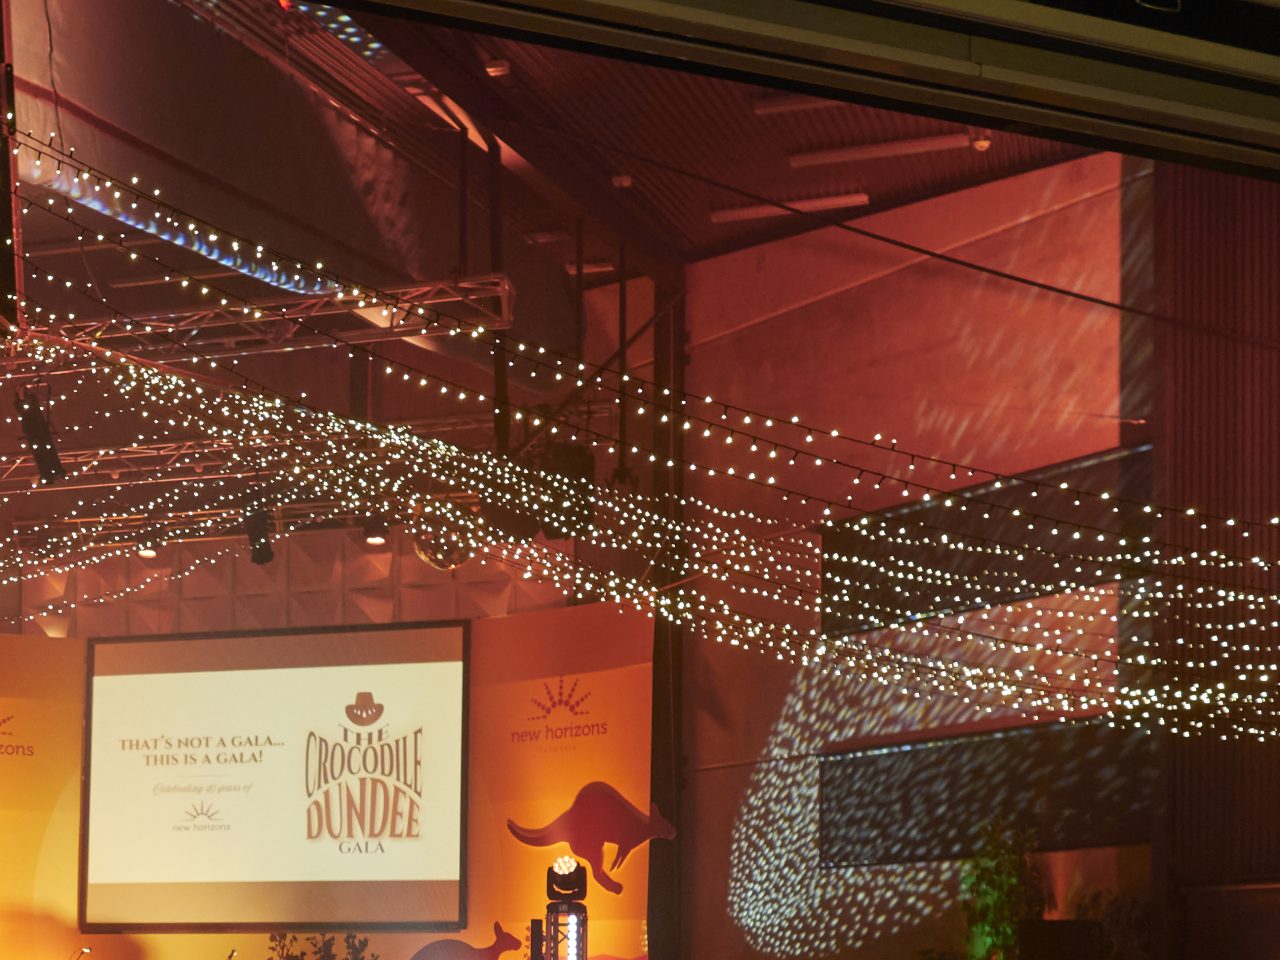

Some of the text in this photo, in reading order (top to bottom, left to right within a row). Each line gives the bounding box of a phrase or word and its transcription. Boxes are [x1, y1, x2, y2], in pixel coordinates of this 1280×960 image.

[338, 723, 390, 746] THE
[511, 721, 608, 744] new horizons
[119, 735, 173, 751] THAT'S
[177, 736, 212, 749] NOT
[216, 735, 227, 748] A
[143, 750, 263, 767] THIS IS A GALA!
[305, 726, 423, 799] CROCODILE
[306, 777, 422, 840] DUNDEE
[193, 823, 231, 832] horizons
[338, 841, 386, 854] GALA
